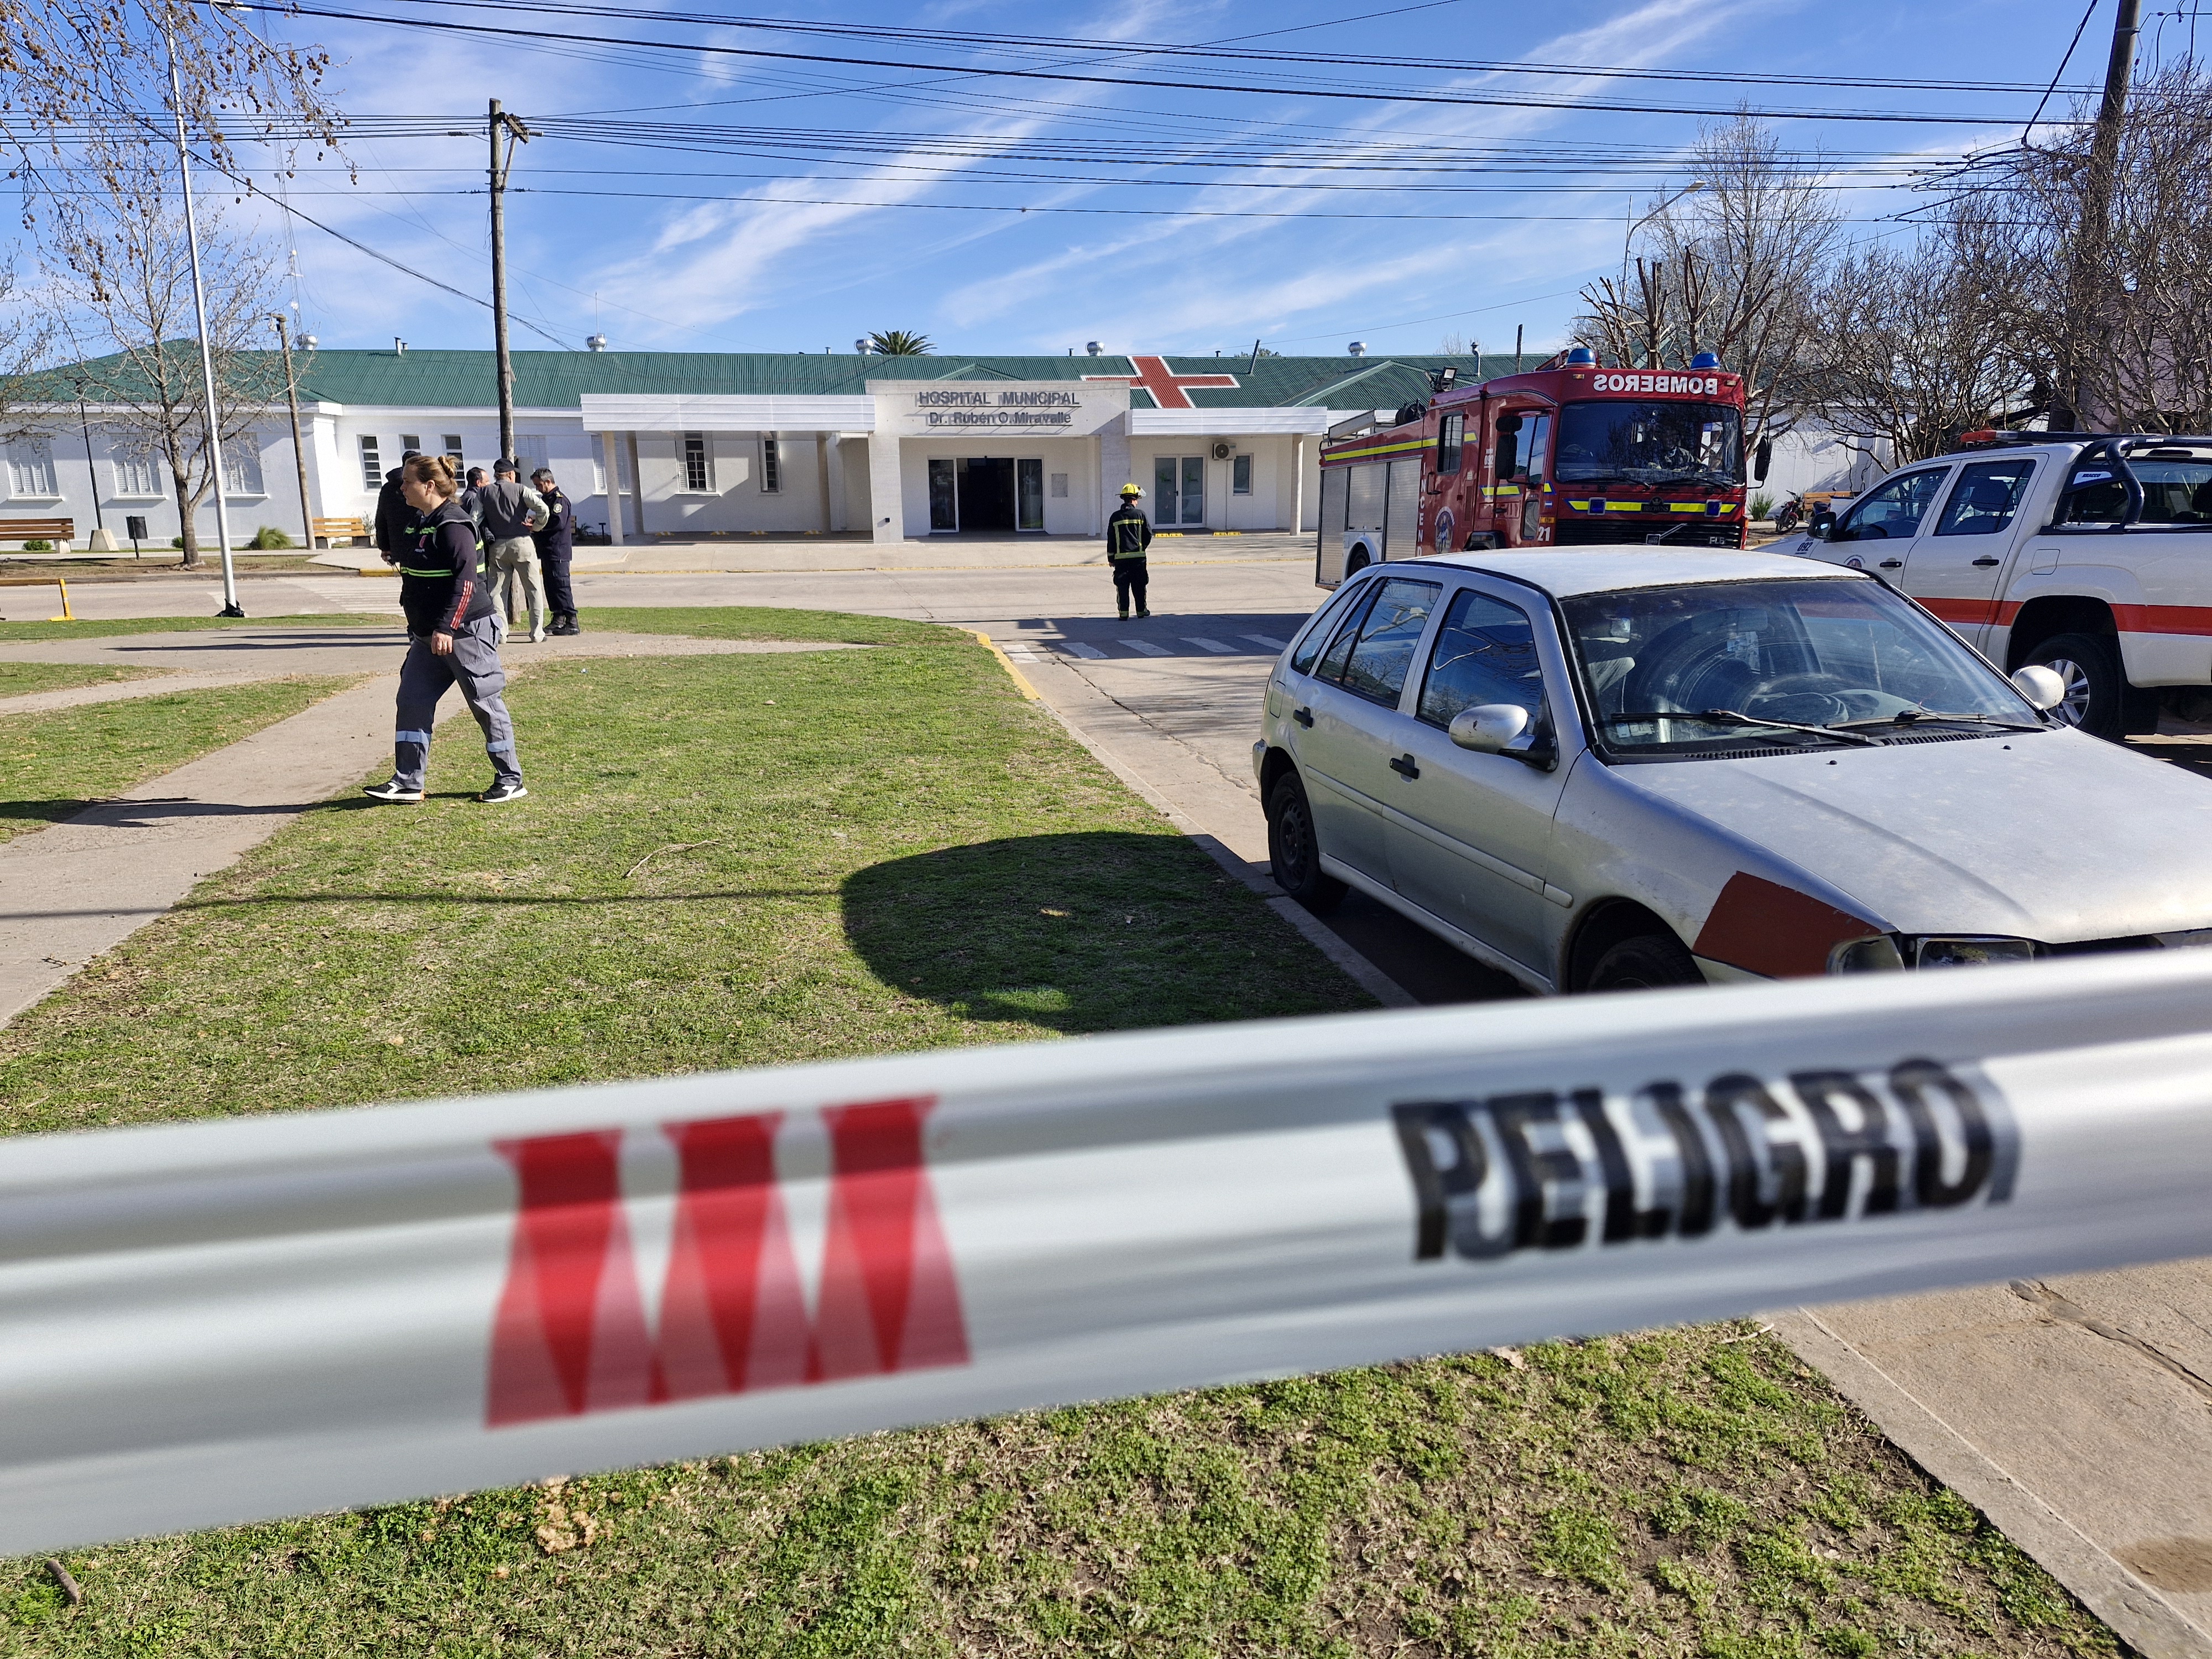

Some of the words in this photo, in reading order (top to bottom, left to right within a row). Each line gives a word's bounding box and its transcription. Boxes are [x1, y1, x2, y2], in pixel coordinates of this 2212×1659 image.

[919, 392, 991, 404] HOSPITAL
[1003, 392, 1079, 404] MUNICIPAL
[930, 412, 947, 424] Dr.
[954, 411, 995, 424] Rubén
[1484, 455, 1494, 465] 092
[1537, 526, 1551, 541] 21
[1797, 541, 1813, 551] 092
[1390, 1057, 1993, 1262] PELIGRO
